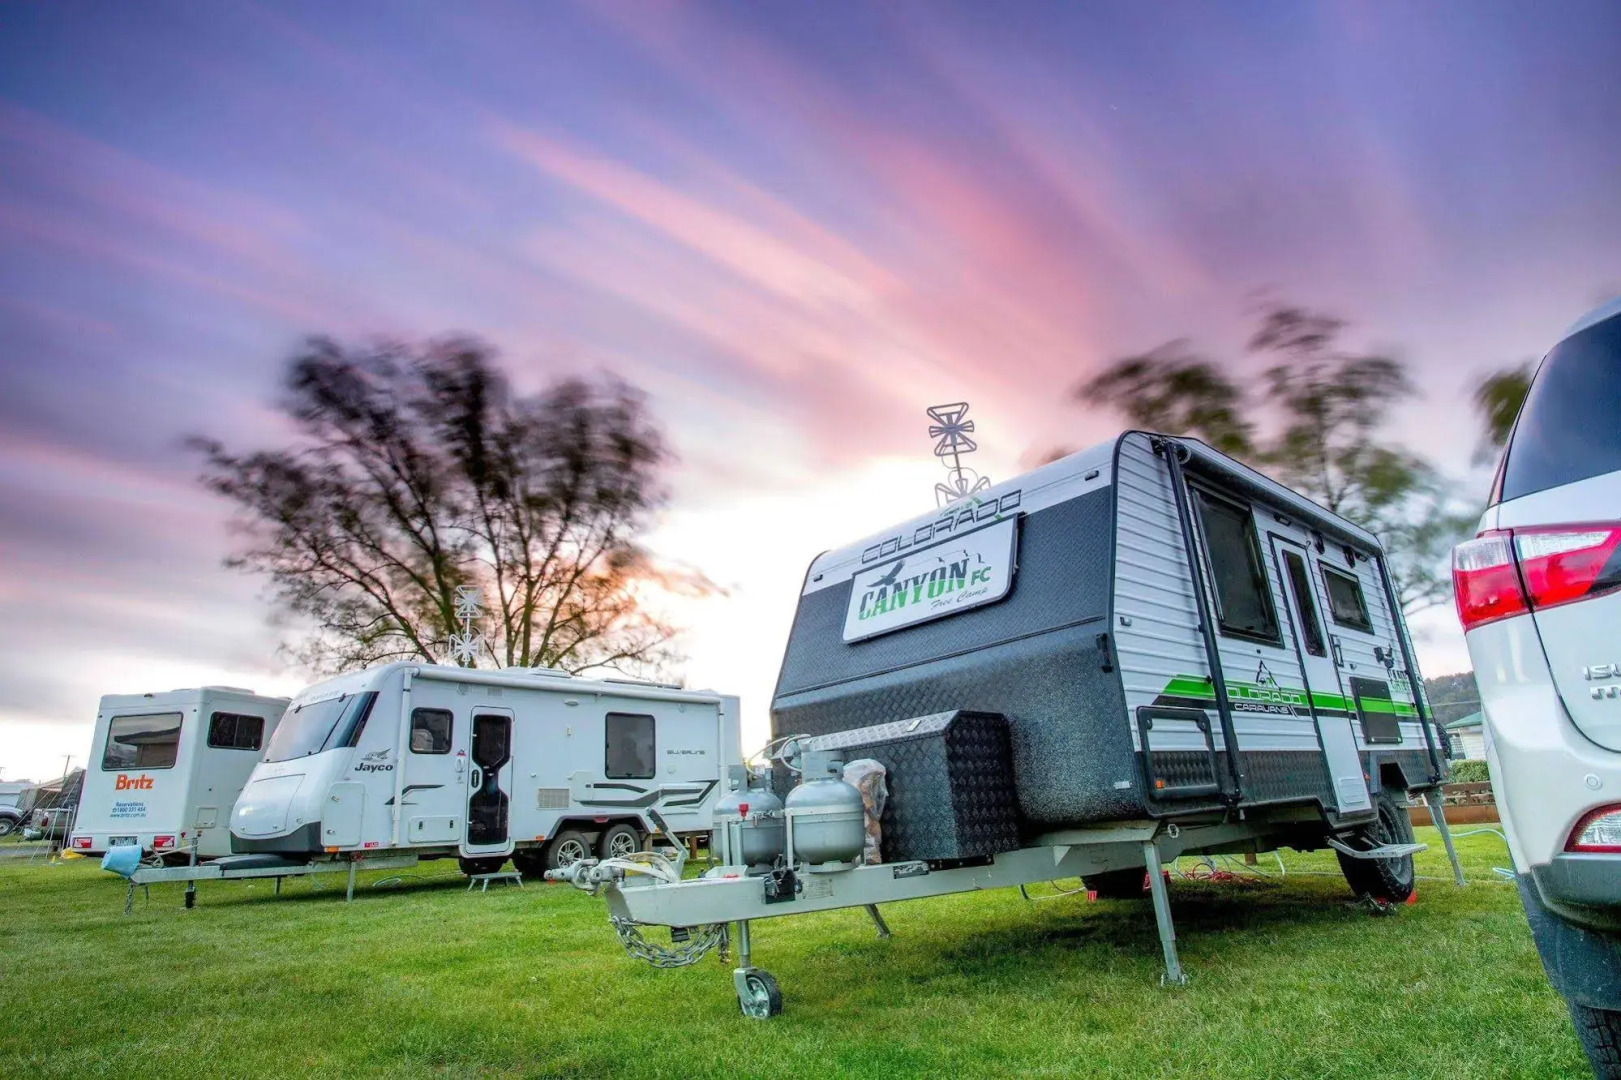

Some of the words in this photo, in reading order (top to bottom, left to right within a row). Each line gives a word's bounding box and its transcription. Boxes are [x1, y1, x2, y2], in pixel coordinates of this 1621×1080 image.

[861, 489, 1022, 564] COLORADO
[858, 557, 970, 621] CANYON
[970, 565, 992, 586] FC
[930, 598, 952, 611] Free
[956, 586, 988, 603] Camp
[1214, 686, 1302, 705] OLORADO
[1234, 703, 1289, 714] CARAVANS
[354, 762, 394, 773] Jayco
[115, 773, 154, 790] Britz
